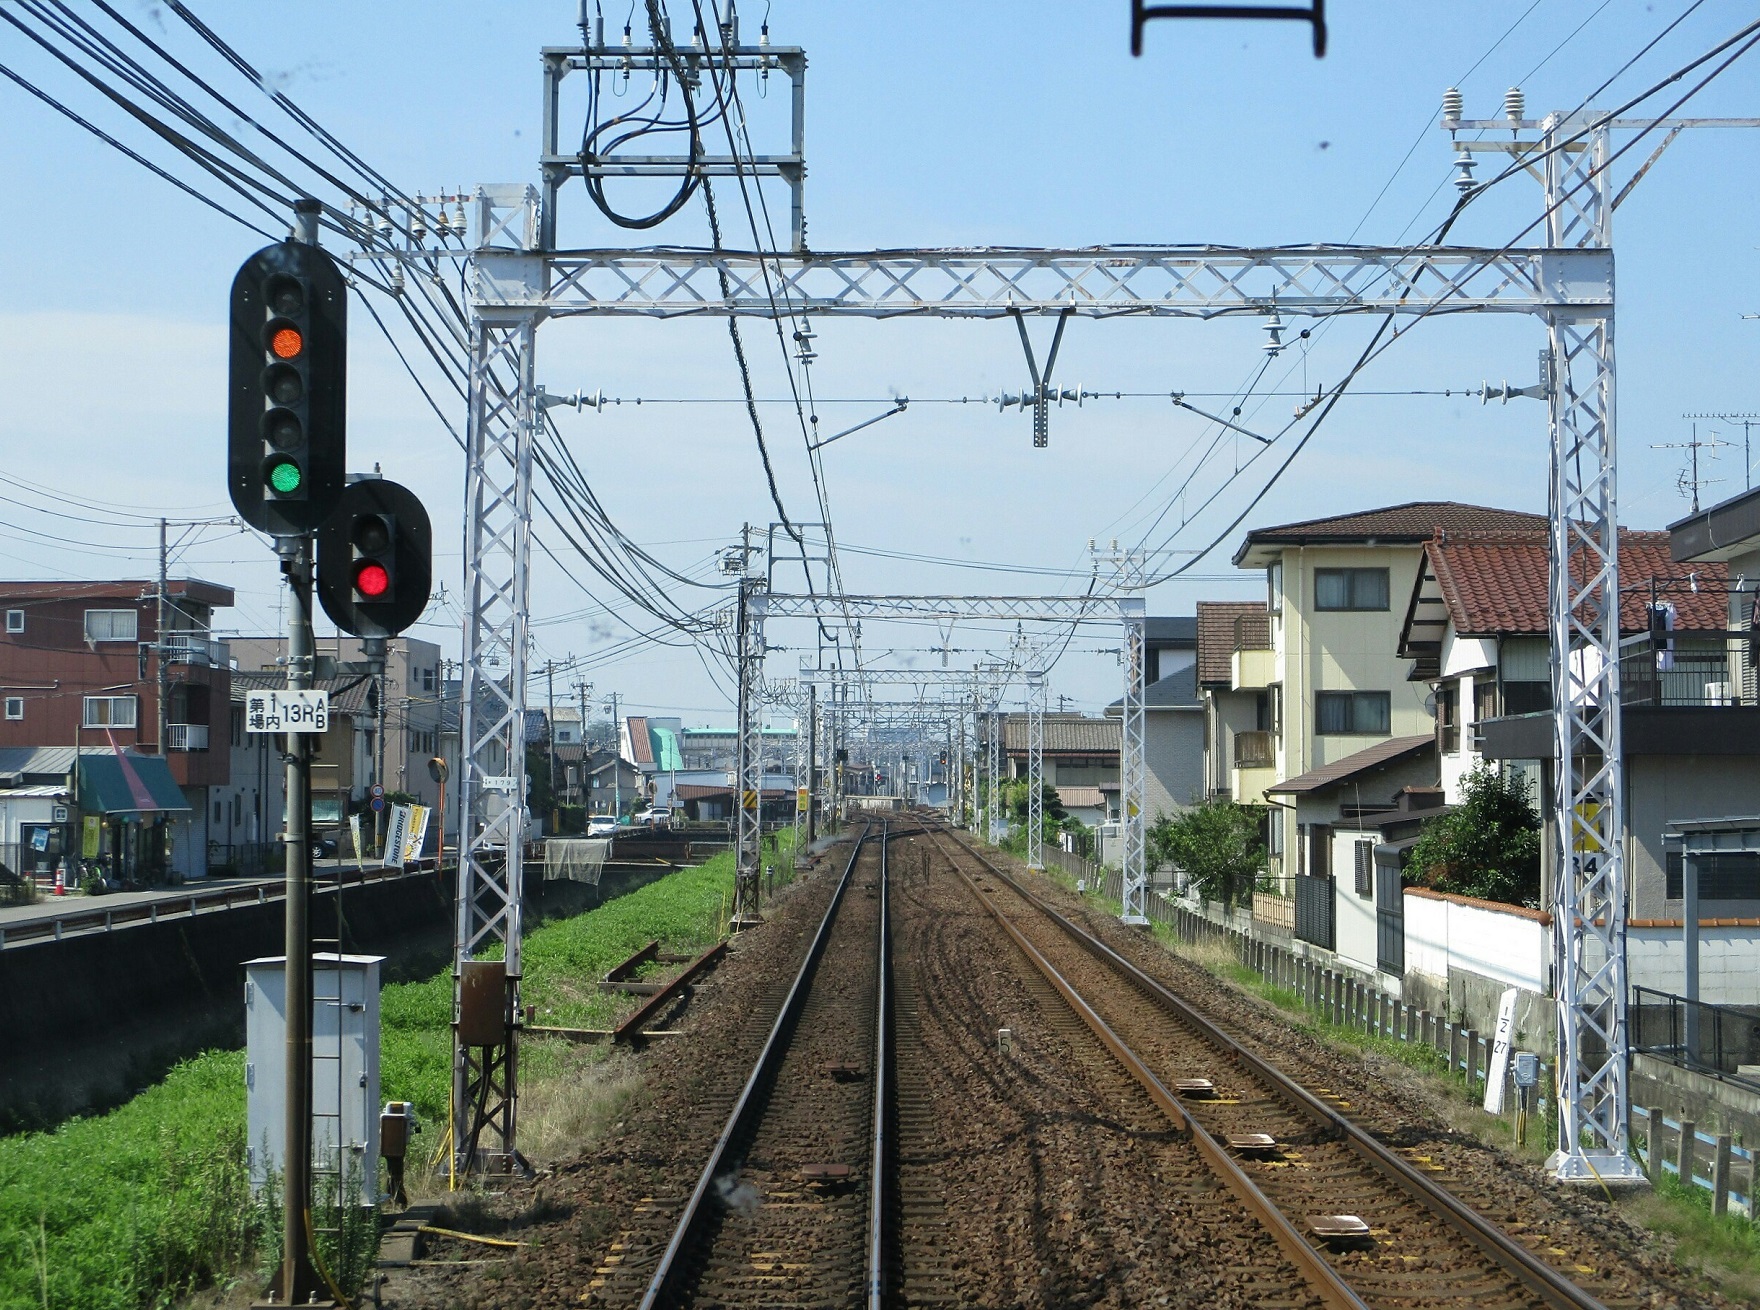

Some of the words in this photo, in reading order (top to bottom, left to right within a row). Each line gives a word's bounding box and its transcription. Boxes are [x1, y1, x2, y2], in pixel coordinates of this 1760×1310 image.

[316, 698, 326, 712] A
[283, 705, 314, 722] 13R
[316, 715, 325, 729] B
[392, 809, 406, 864] BRIDGESTONE
[1001, 1037, 1010, 1053] 5
[1494, 1041, 1506, 1054] 27
